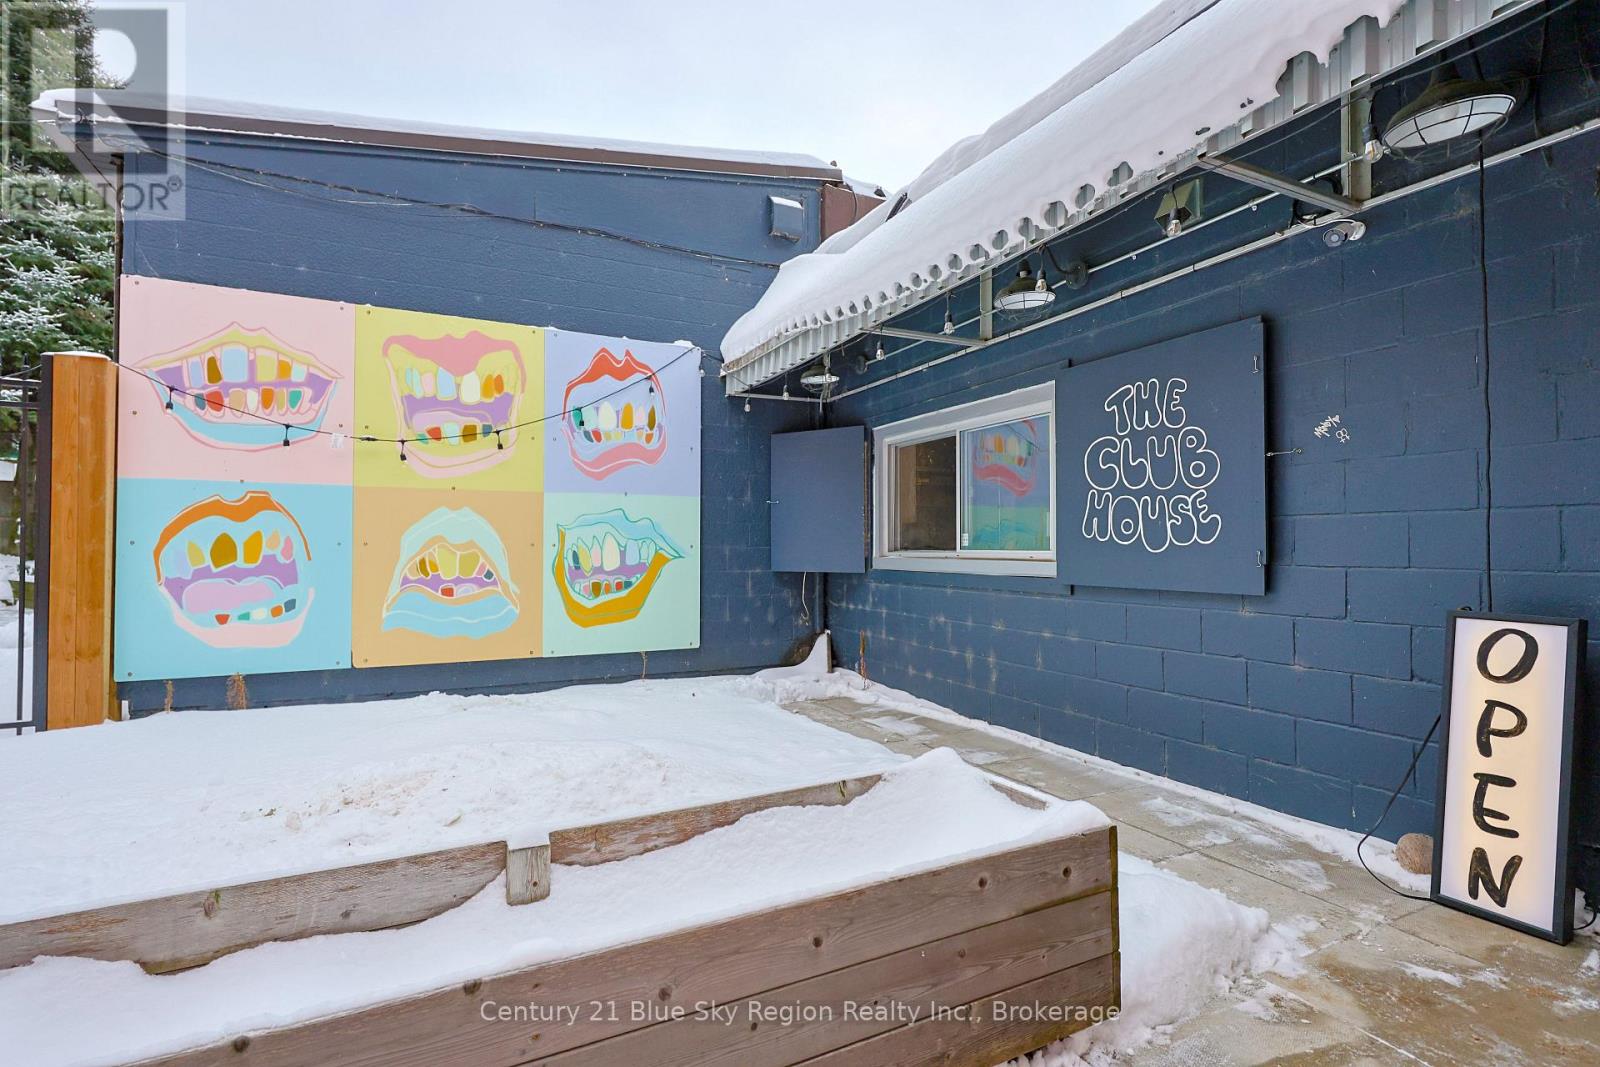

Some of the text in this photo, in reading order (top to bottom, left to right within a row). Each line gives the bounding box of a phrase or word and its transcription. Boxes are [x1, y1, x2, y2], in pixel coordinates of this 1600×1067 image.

[1104, 377, 1188, 436] THE
[1084, 426, 1221, 490] CLUB
[1082, 489, 1222, 553] HOUSE
[1467, 627, 1539, 908] OPEN
